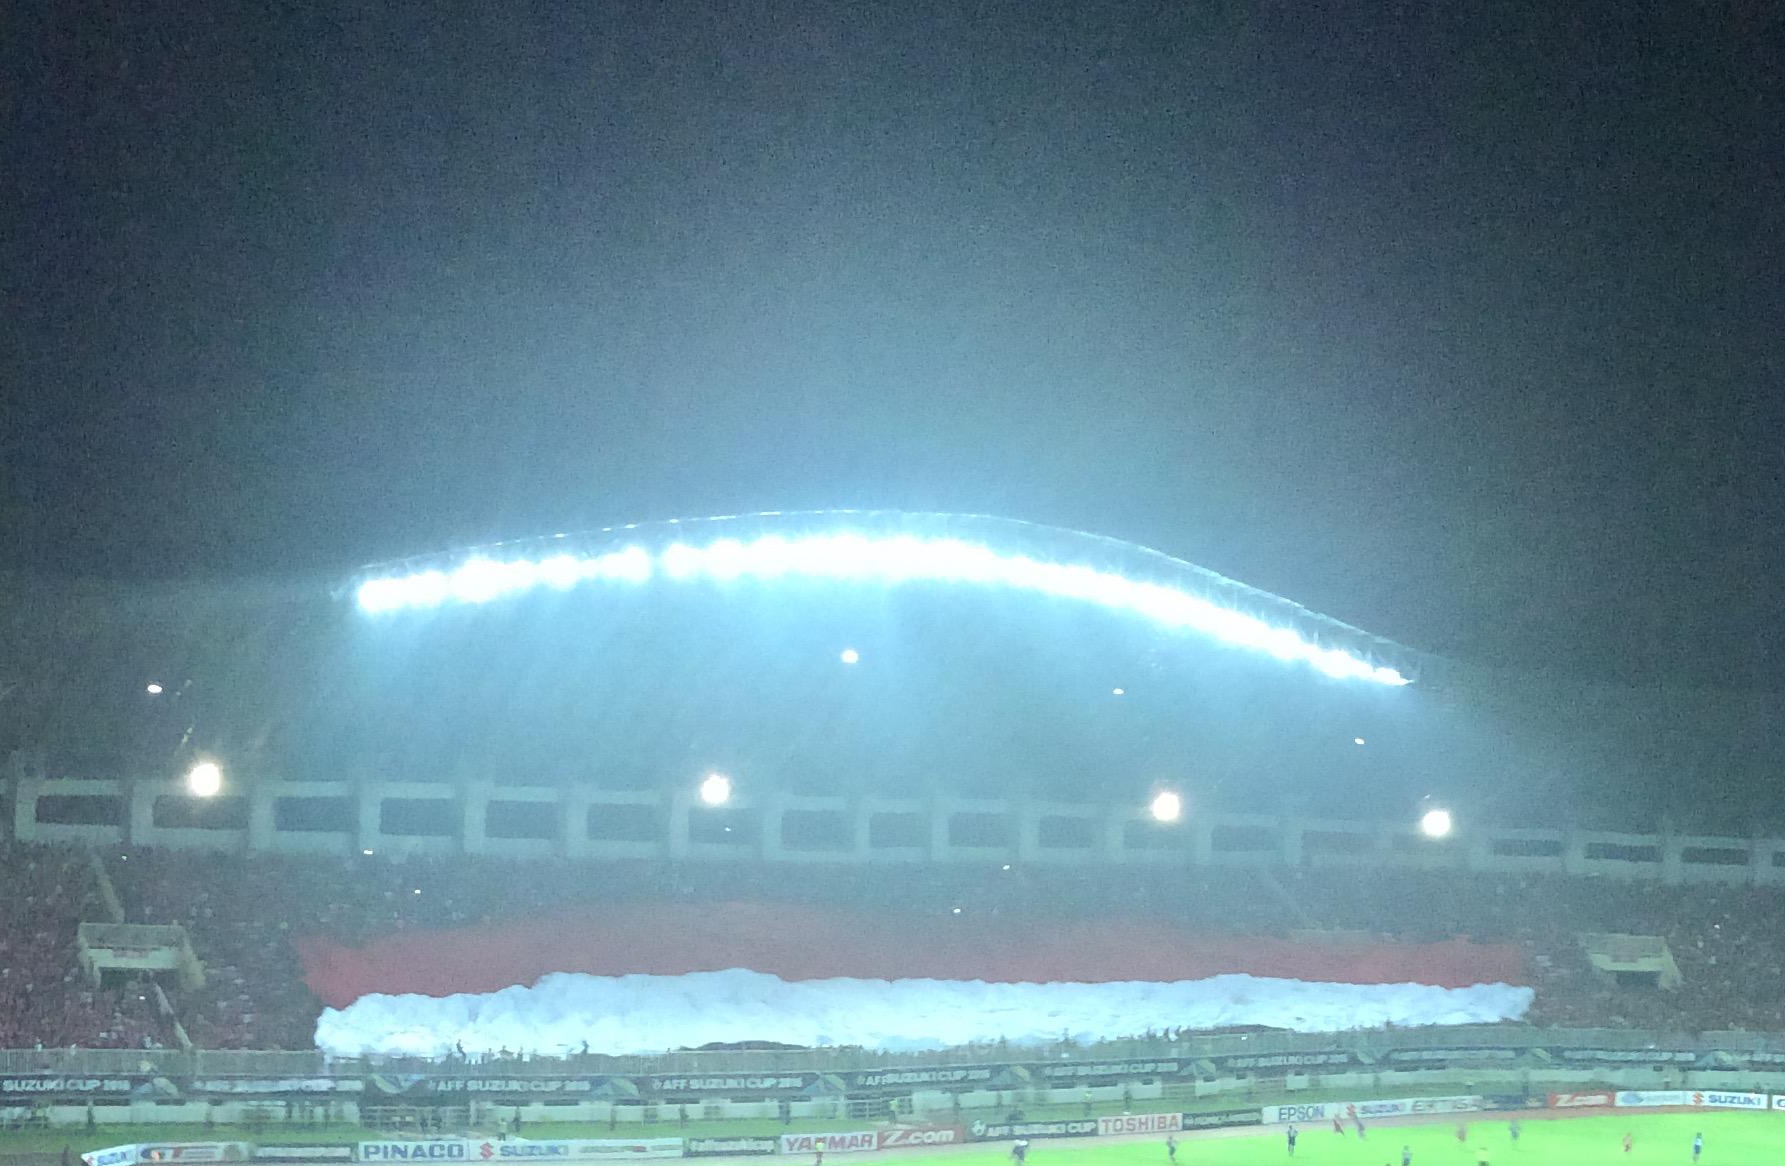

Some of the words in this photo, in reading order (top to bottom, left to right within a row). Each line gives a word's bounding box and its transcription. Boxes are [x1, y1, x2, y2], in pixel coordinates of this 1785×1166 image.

[1129, 1063, 1157, 1074] CUP
[938, 1071, 966, 1082] CUP
[3, 1080, 65, 1091] SUZUKI
[66, 1080, 101, 1091] CUP
[467, 1080, 529, 1091] SUZUKI
[530, 1080, 562, 1091] CUP
[690, 1078, 745, 1090] SUZUKI
[746, 1078, 777, 1089] CUP
[1709, 1094, 1761, 1106] SUZUKI
[1279, 1104, 1325, 1121] EPSON
[1067, 1121, 1097, 1134] CUP
[1102, 1115, 1180, 1134] TOSHIBA
[883, 1129, 955, 1146] Z.com
[363, 1143, 464, 1160] PINACO
[499, 1144, 569, 1157] SUZUKI
